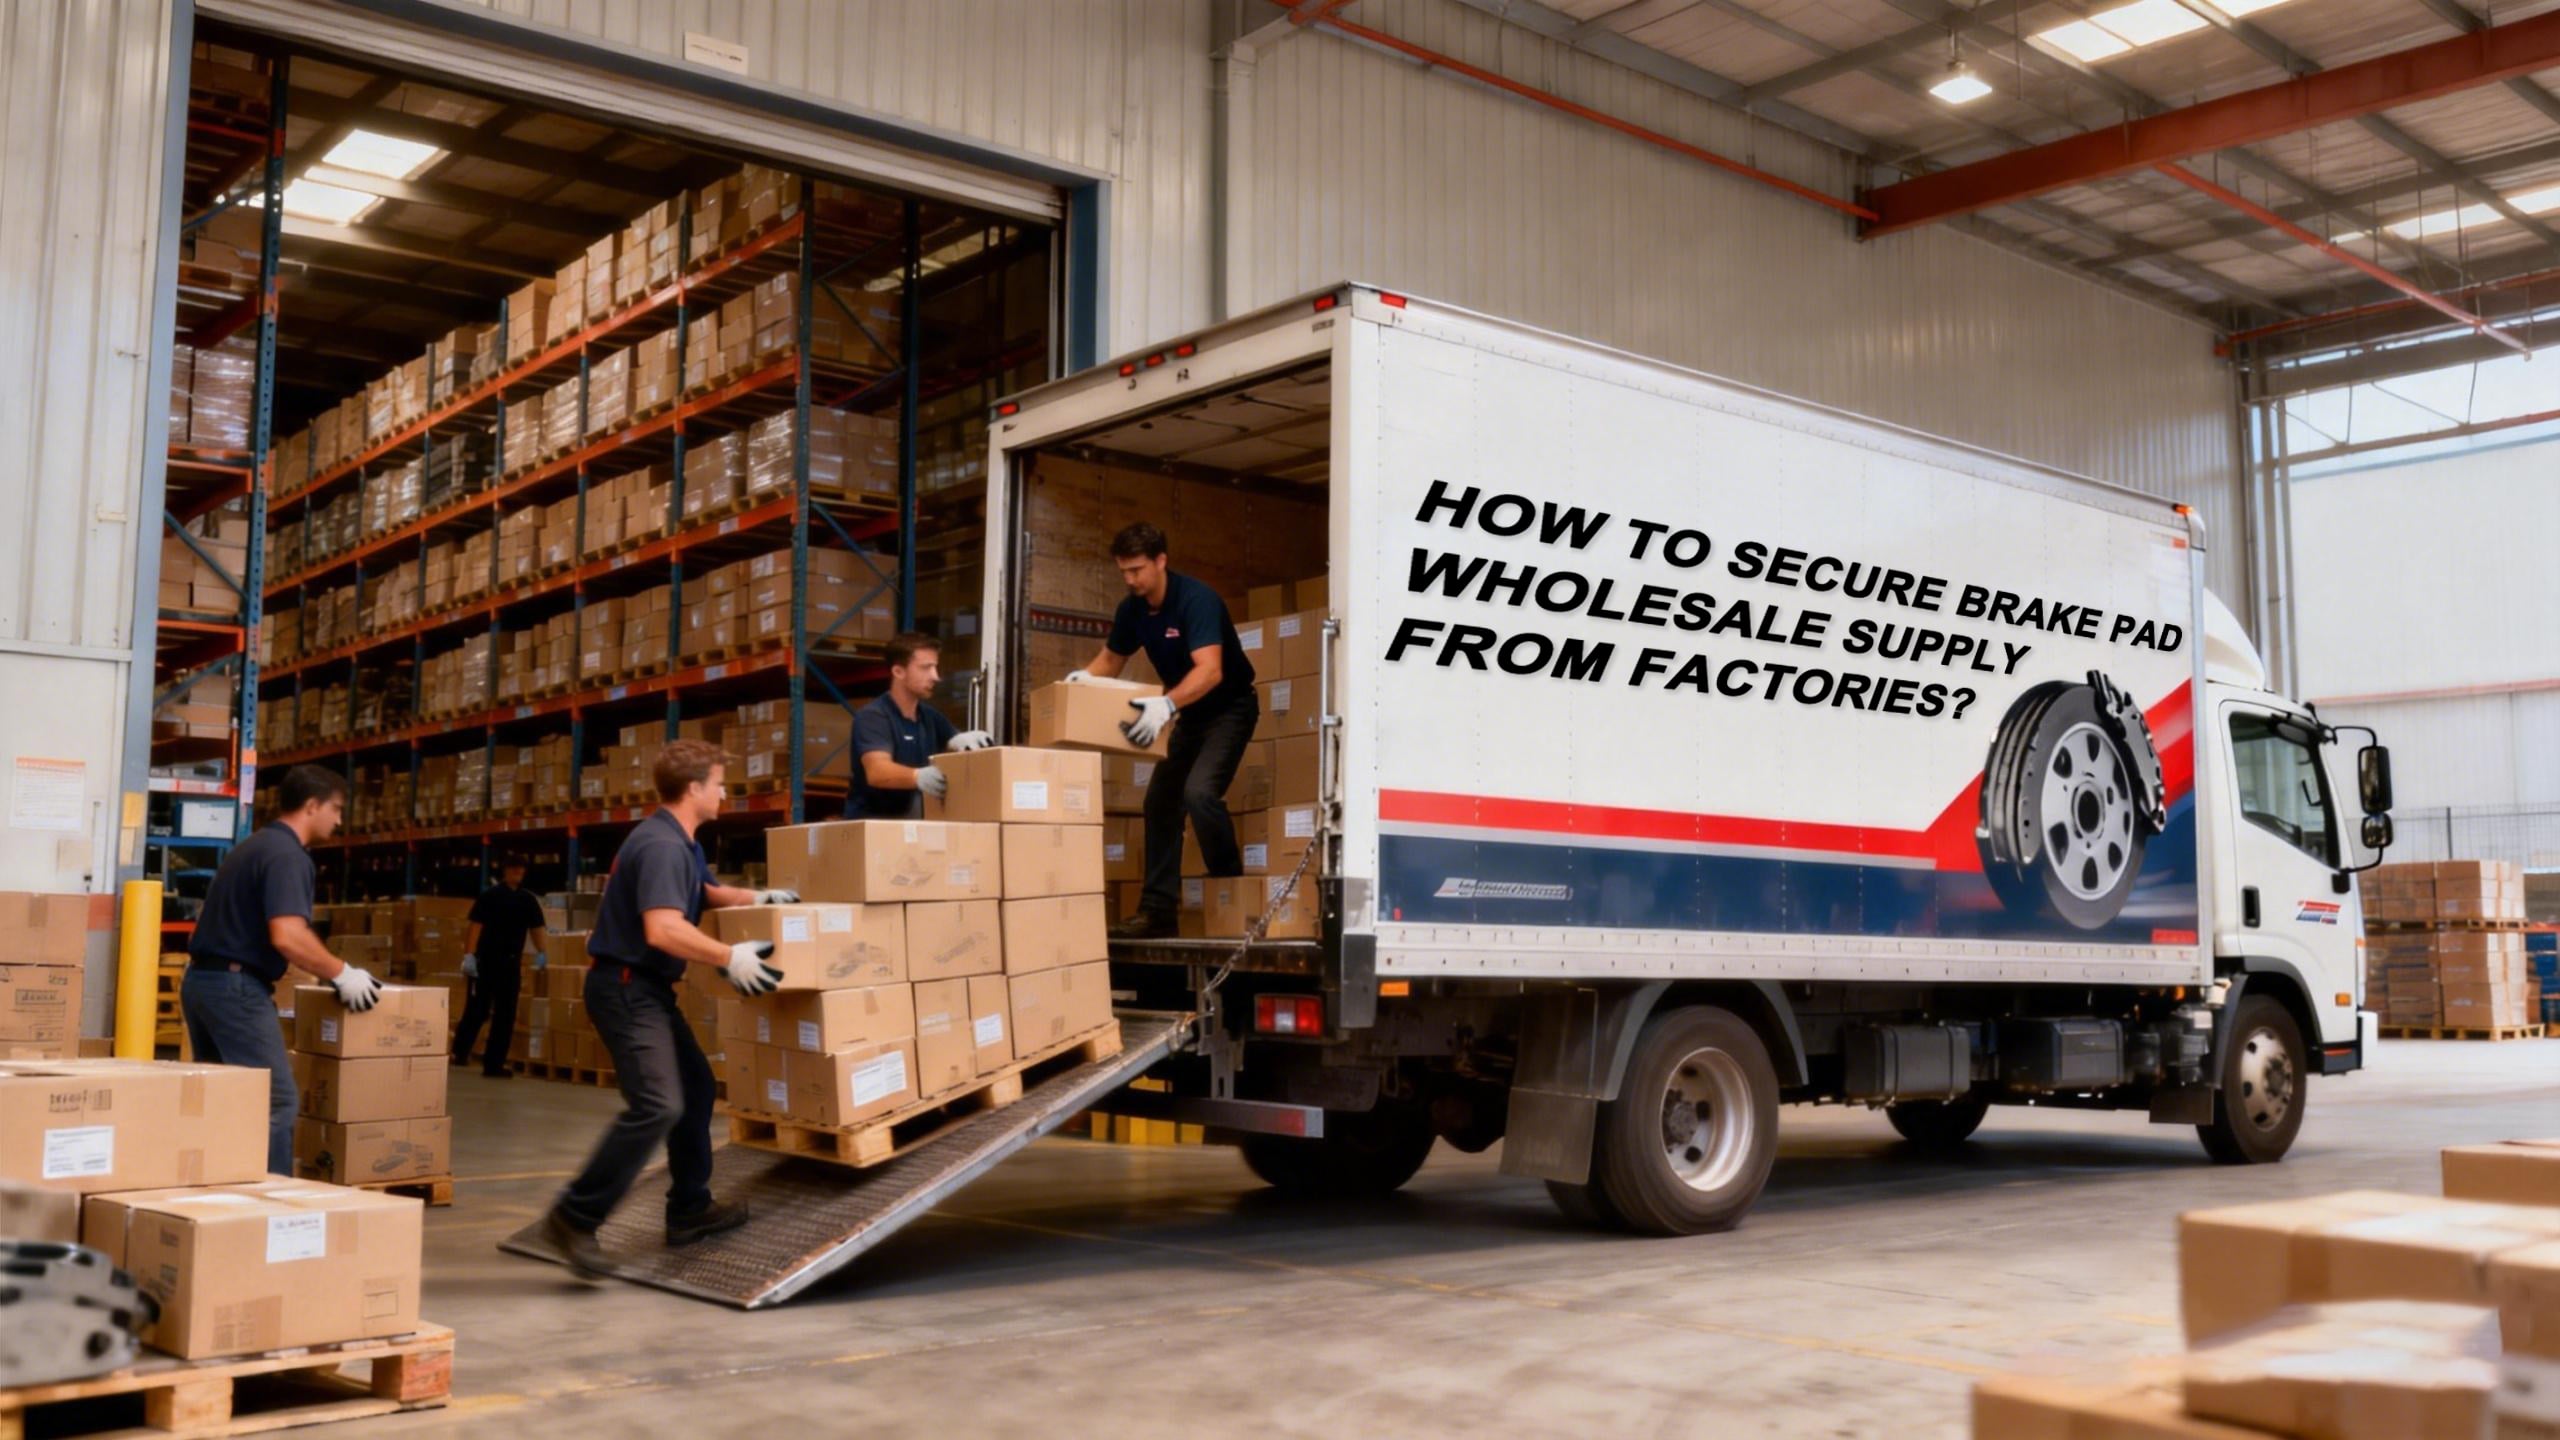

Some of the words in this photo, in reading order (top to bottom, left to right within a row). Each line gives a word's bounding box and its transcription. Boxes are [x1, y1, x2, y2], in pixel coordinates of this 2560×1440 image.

[1406, 546, 1833, 650] WHOLESALE
[1841, 618, 2033, 676] SUPPLY
[1414, 479, 1612, 551] HOW
[1627, 518, 1712, 569] TO
[1726, 541, 1949, 613] SECURE
[1954, 584, 2105, 639] BRAKE
[2108, 614, 2184, 653] PAD
[1383, 616, 1617, 683] FROM
[1627, 647, 1978, 721] FACTORIES?
